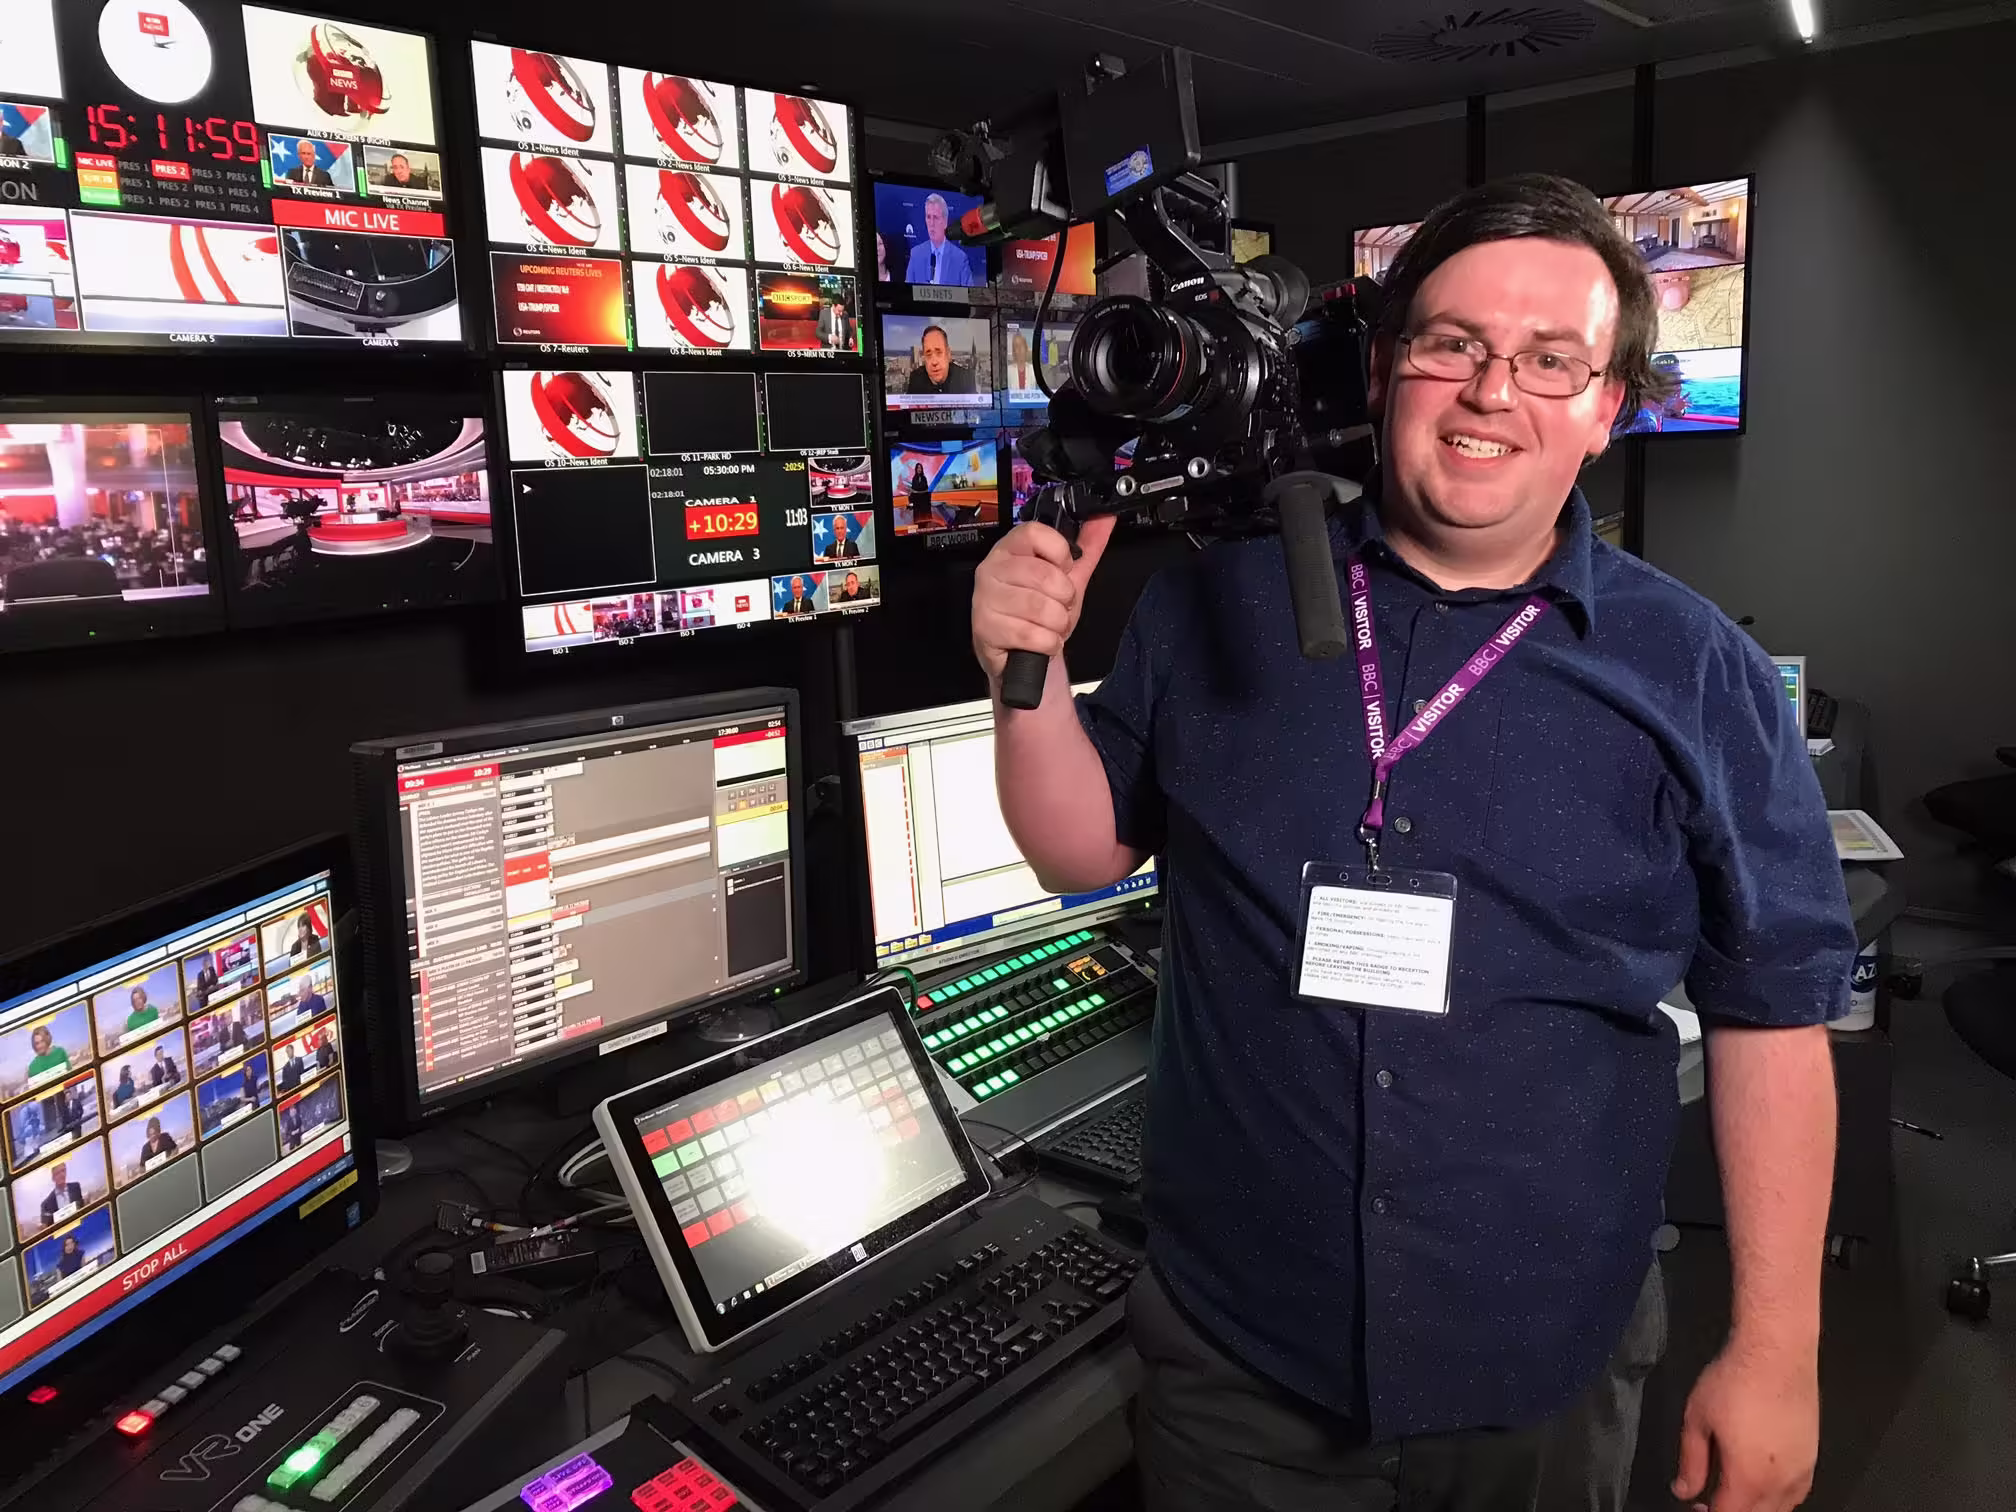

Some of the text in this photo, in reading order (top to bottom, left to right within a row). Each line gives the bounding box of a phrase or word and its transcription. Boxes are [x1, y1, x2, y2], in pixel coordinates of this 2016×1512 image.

[330, 77, 358, 90] NEWS
[518, 141, 579, 157] OS 1-News Ident
[22, 160, 31, 169] 2
[96, 158, 114, 169] LIVE
[118, 160, 138, 171] PRES
[155, 163, 187, 176] PRES 2
[657, 159, 710, 173] OS 2-News Ident
[192, 167, 222, 180] PRES 3
[226, 171, 256, 182] PRES 4
[778, 173, 825, 186] OS 3-News Ident
[120, 176, 143, 188] PRES
[157, 180, 189, 192] PRES 2
[194, 183, 224, 195] PRES 3
[228, 187, 257, 198] PRES 4
[291, 187, 302, 195] TX
[303, 188, 334, 199] Preview
[122, 193, 145, 204] PRES
[159, 196, 190, 208] PRES 2
[383, 195, 430, 206] News Channel
[195, 200, 225, 211] PRES 3
[230, 203, 259, 214] PRES 4
[325, 208, 400, 231] MIC LIVE
[526, 243, 587, 256] OS 4-News Ident
[664, 253, 716, 265] OS 5-News Ident
[520, 264, 555, 275] UPCOMING
[556, 267, 585, 277] REUTERS
[783, 262, 829, 274] OS 6-News Ident
[1170, 276, 1205, 293] Canon
[919, 288, 953, 300] US NETS
[1194, 293, 1208, 302] EOS
[169, 334, 215, 343] CAMERA 5
[362, 338, 392, 347] CAMERA
[540, 344, 589, 354] OS 7-Reuters
[670, 347, 679, 356] OS
[706, 348, 722, 357] Ident
[914, 412, 939, 422] NEWS
[545, 457, 608, 468] OS 10-News Ident
[681, 452, 732, 462] OS 11-PARK HD
[650, 467, 684, 478] 02:18:01
[703, 464, 755, 476] 05:30:00 PM
[652, 490, 685, 499] 02:18:01
[685, 496, 757, 507] CAMERA 1
[689, 511, 758, 534] +10:29
[785, 508, 808, 527] 11:03
[689, 548, 760, 566] CAMERA 3
[1351, 563, 1372, 650] BBC VISITOR
[680, 630, 690, 638] ISO
[1469, 604, 1541, 676] BBC VISITOR
[553, 648, 565, 656] ISO
[1362, 663, 1385, 759] BBC VISITOR
[1411, 683, 1465, 734] VISITOR
[121, 1242, 188, 1292] STOP ALL
[234, 1402, 285, 1443] ONE
